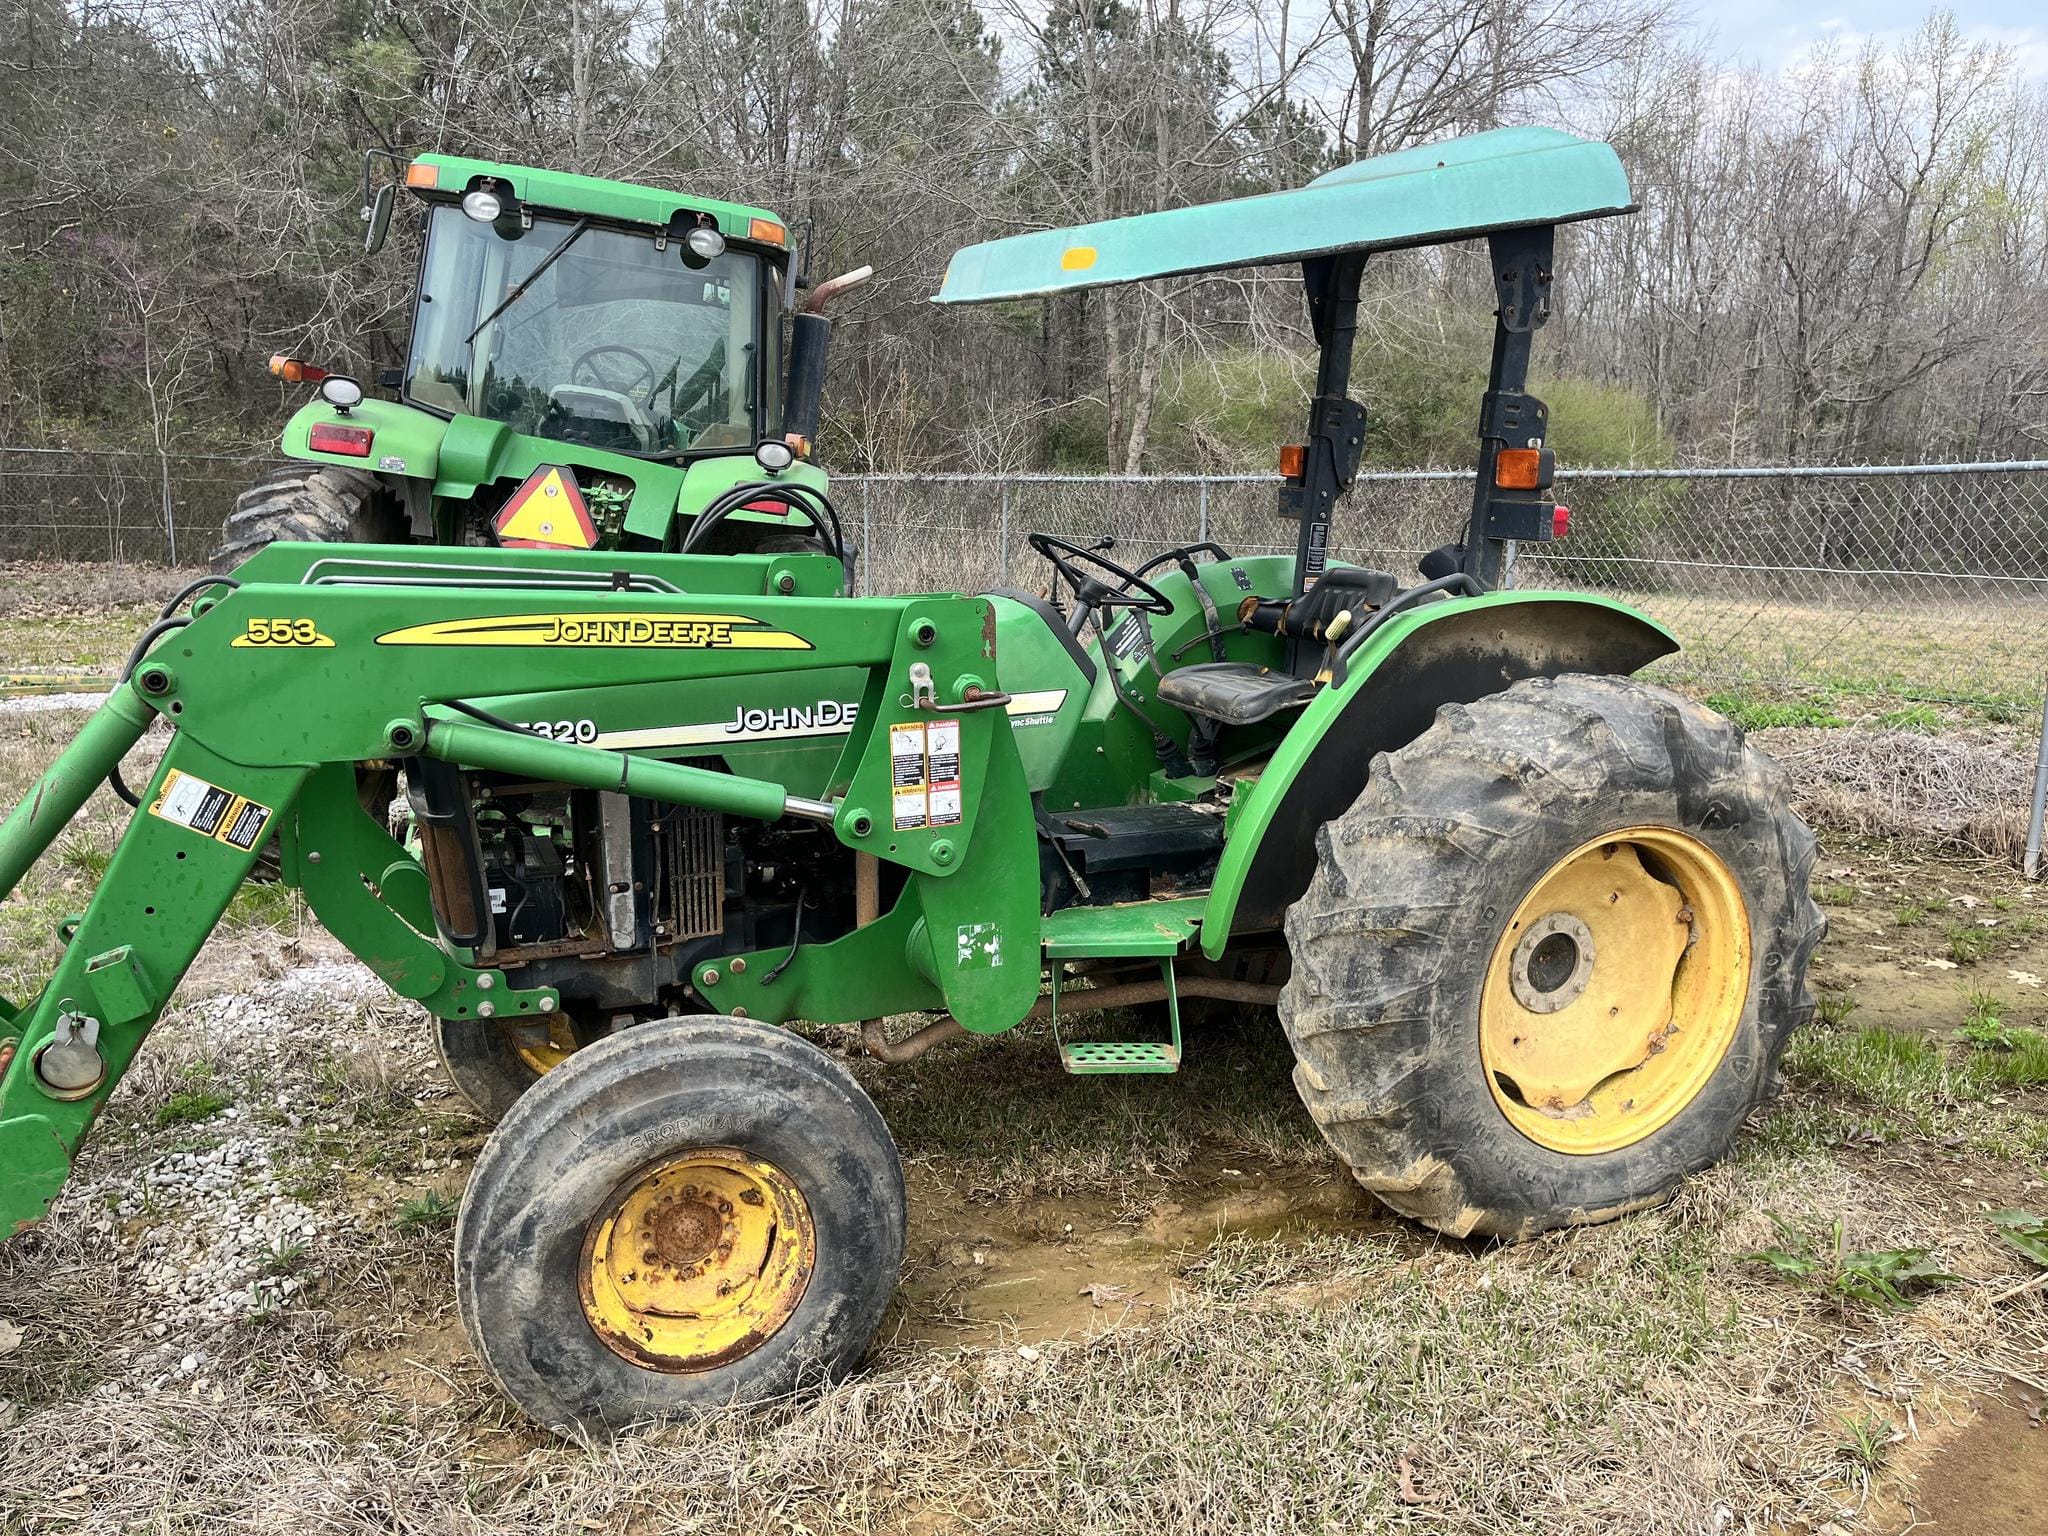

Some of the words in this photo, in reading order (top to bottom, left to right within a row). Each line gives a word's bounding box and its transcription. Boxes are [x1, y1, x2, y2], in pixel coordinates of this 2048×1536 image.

[247, 618, 317, 644] 553
[513, 720, 598, 743] 320
[1009, 716, 1055, 729] yncShuttle
[937, 783, 958, 791] DANGER
[225, 801, 244, 829] WARNING
[630, 1118, 690, 1151] CROP
[700, 1113, 751, 1132] MAX
